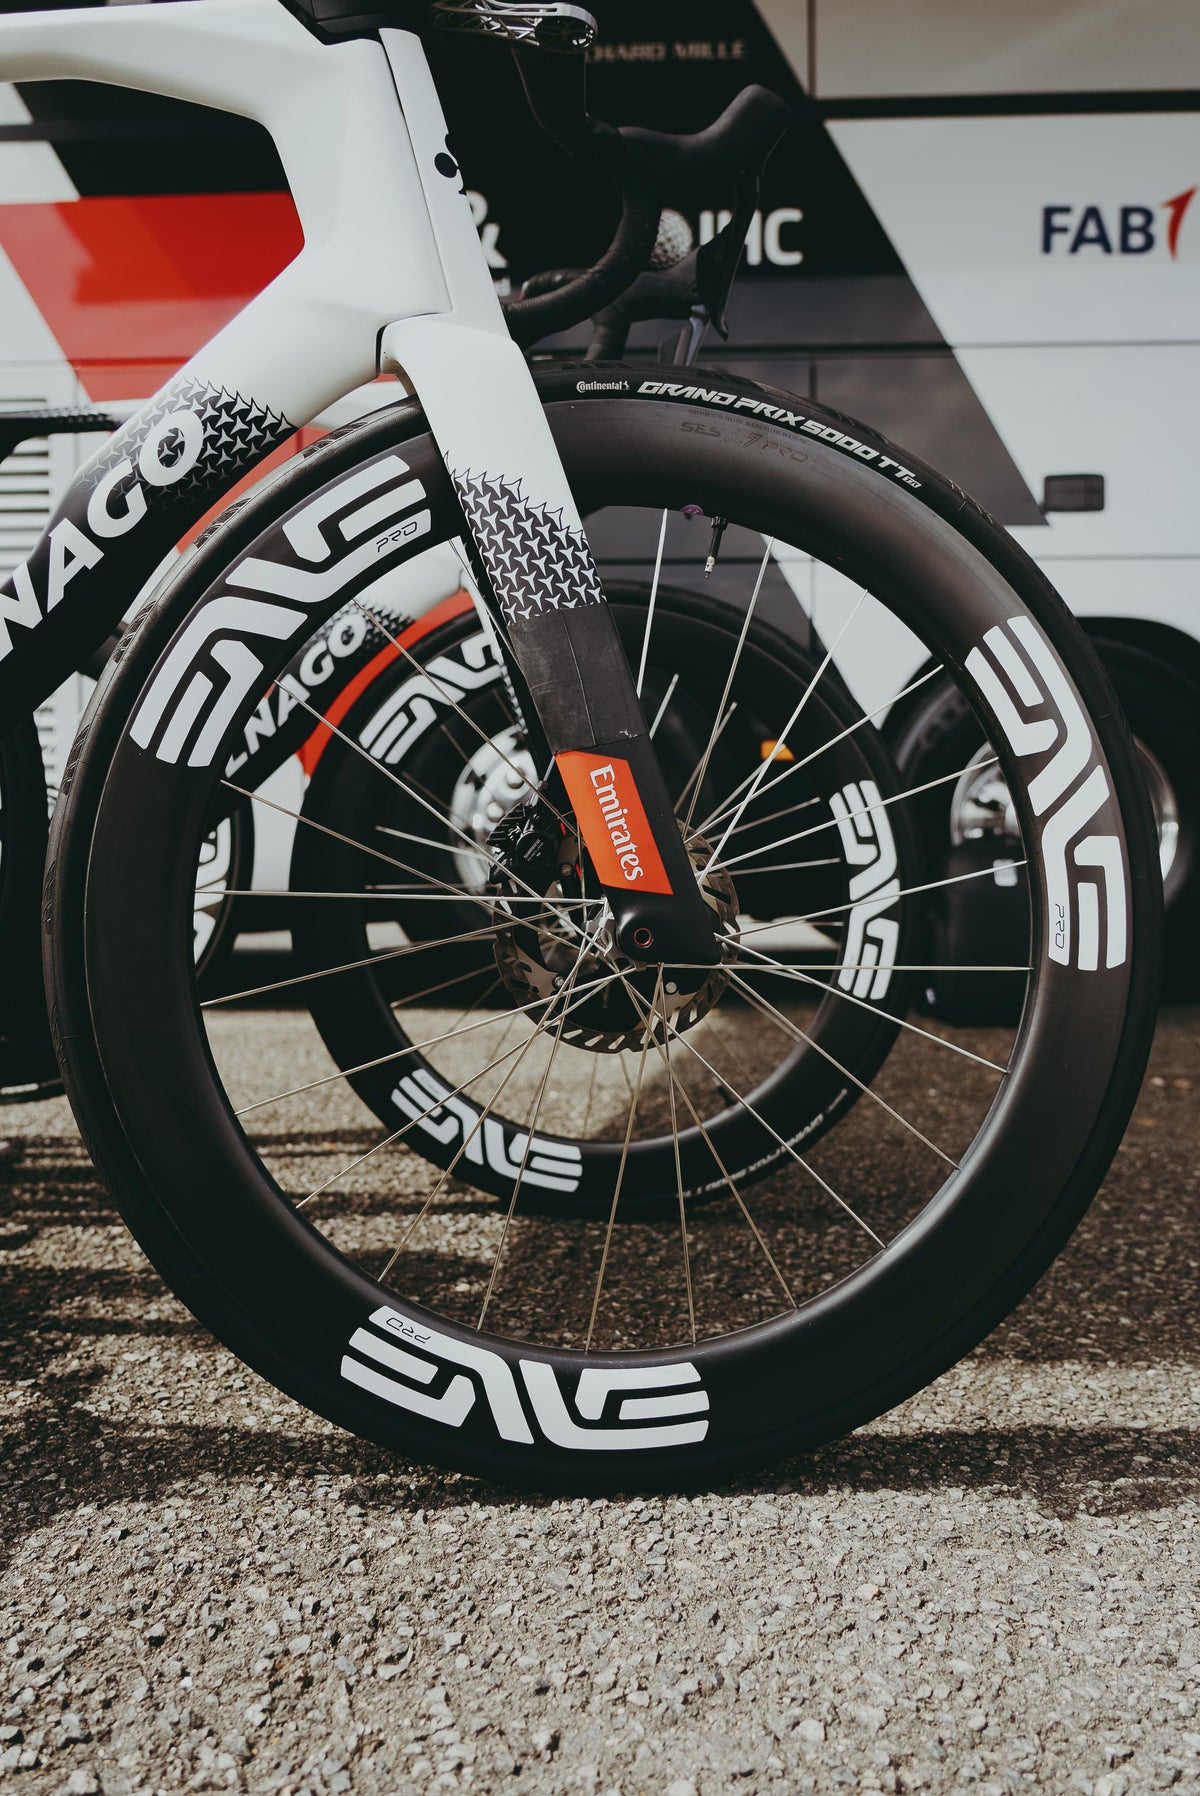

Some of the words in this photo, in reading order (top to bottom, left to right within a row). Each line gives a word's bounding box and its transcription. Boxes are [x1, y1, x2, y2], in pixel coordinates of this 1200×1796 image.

[586, 43, 667, 62] HARD
[576, 380, 623, 394] Continental
[637, 381, 738, 404] GRAND
[733, 397, 805, 427] PRIX
[800, 419, 880, 461] 5000
[878, 455, 916, 478] TT
[376, 521, 418, 553] PRO
[589, 763, 644, 882] Emirates
[1054, 903, 1065, 949] PRO
[386, 1317, 432, 1344] PRO
